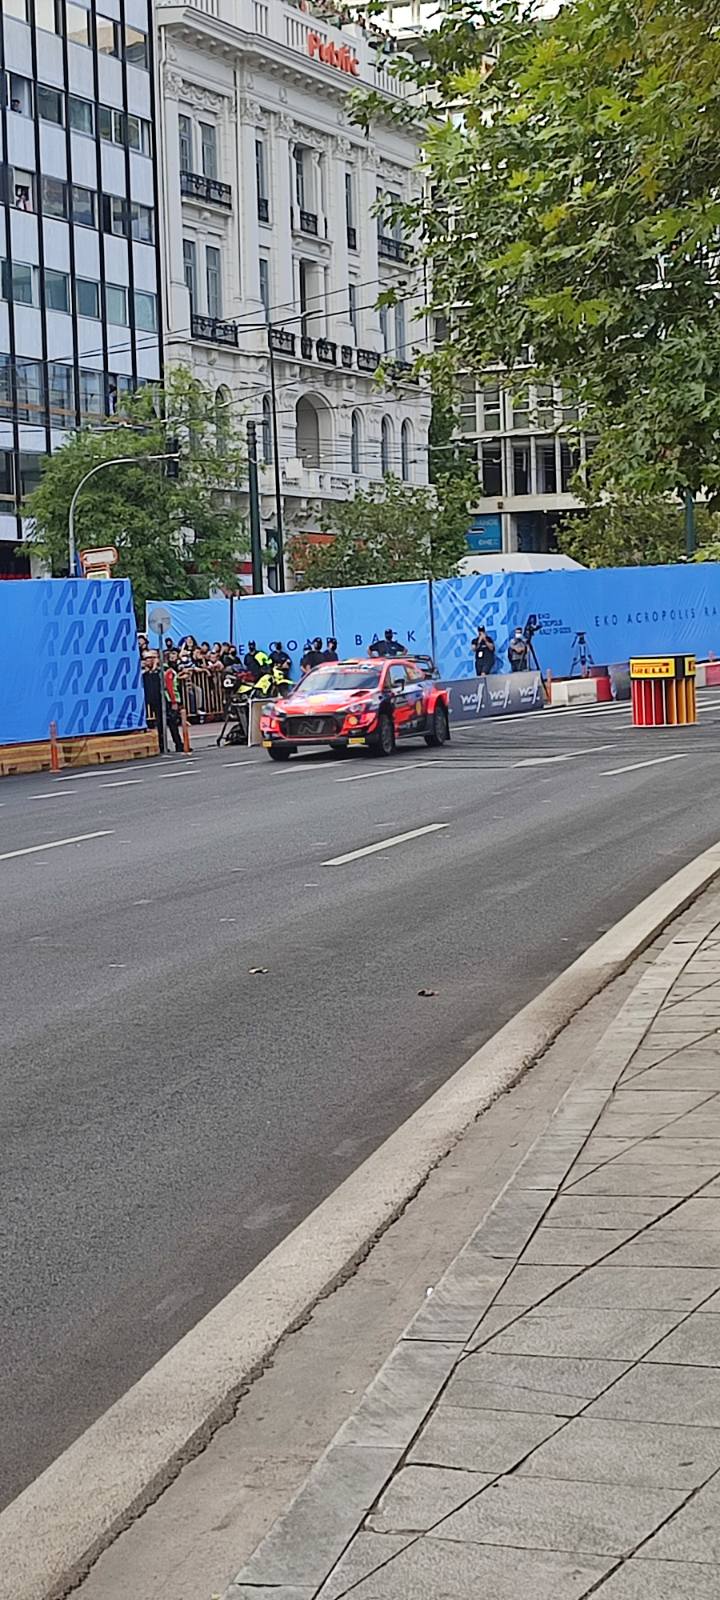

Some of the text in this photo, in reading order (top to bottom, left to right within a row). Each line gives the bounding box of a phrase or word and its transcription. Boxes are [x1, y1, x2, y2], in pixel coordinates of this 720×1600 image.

[308, 32, 360, 77] Public
[594, 615, 618, 628] EKO
[627, 607, 695, 624] ACROPOLIS
